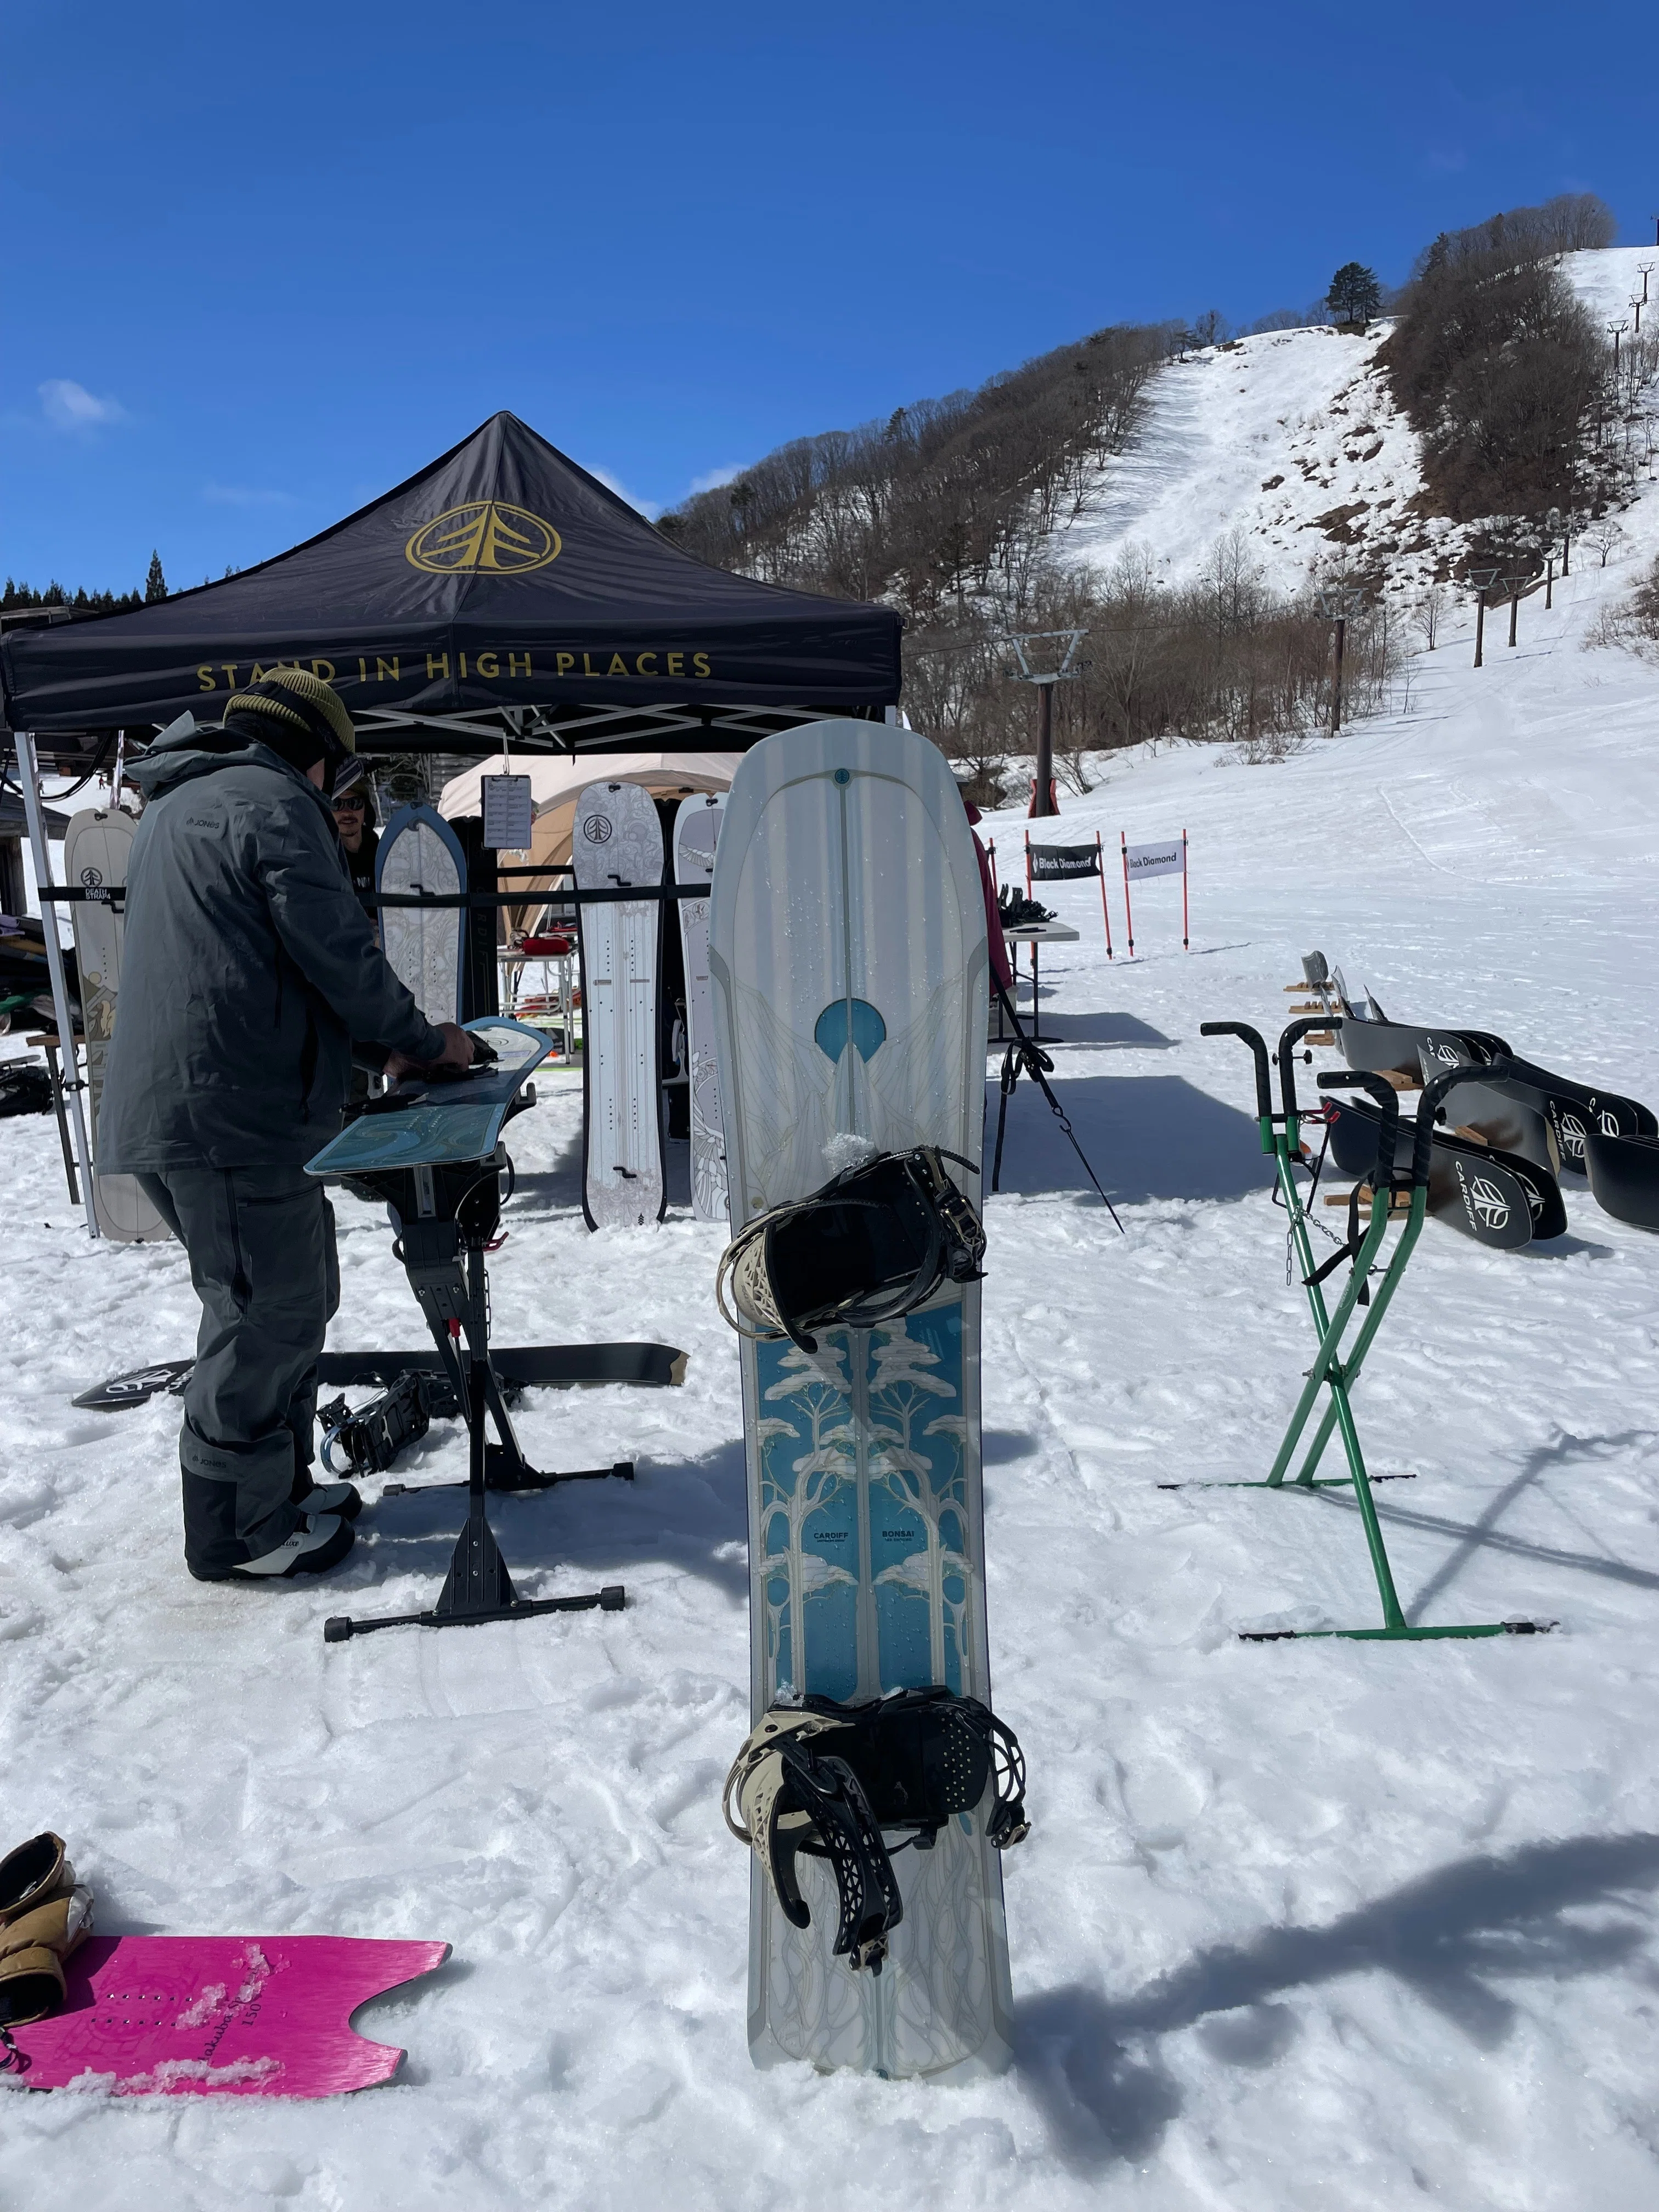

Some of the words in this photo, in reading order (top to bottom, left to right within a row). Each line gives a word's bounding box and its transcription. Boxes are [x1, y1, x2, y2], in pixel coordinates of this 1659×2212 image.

[358, 656, 400, 682] IN
[426, 652, 533, 679] HIGH
[556, 652, 712, 678] PLACES
[1039, 857, 1059, 870] Black
[1058, 856, 1092, 869] Diamond
[1143, 851, 1177, 867] Diamond
[1549, 1100, 1566, 1161] CARDIFF
[1455, 1160, 1477, 1232] CARDIFF
[241, 2004, 262, 2027] 150
